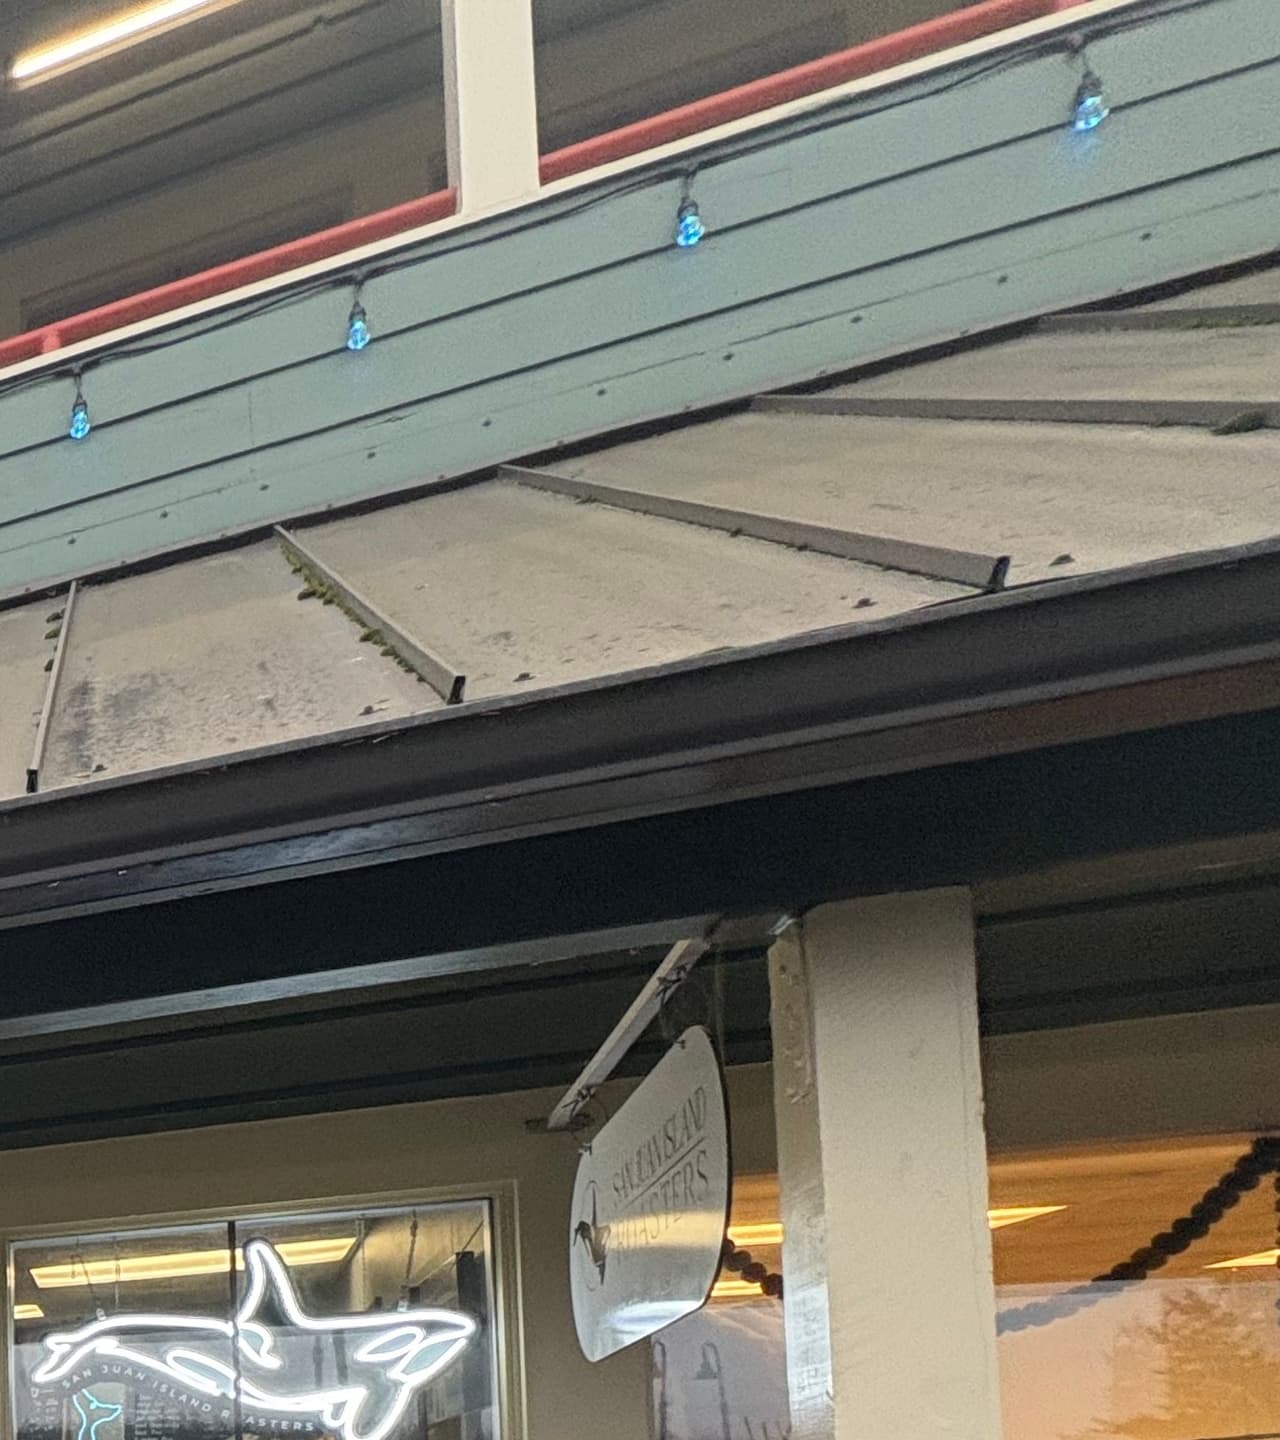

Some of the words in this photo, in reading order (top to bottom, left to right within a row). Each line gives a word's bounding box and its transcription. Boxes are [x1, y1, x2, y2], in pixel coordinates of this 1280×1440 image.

[61, 1367, 93, 1389] SAN
[102, 1364, 146, 1381] JUAN
[152, 1380, 212, 1413] ISLAND
[221, 1408, 315, 1432] RASTERS
